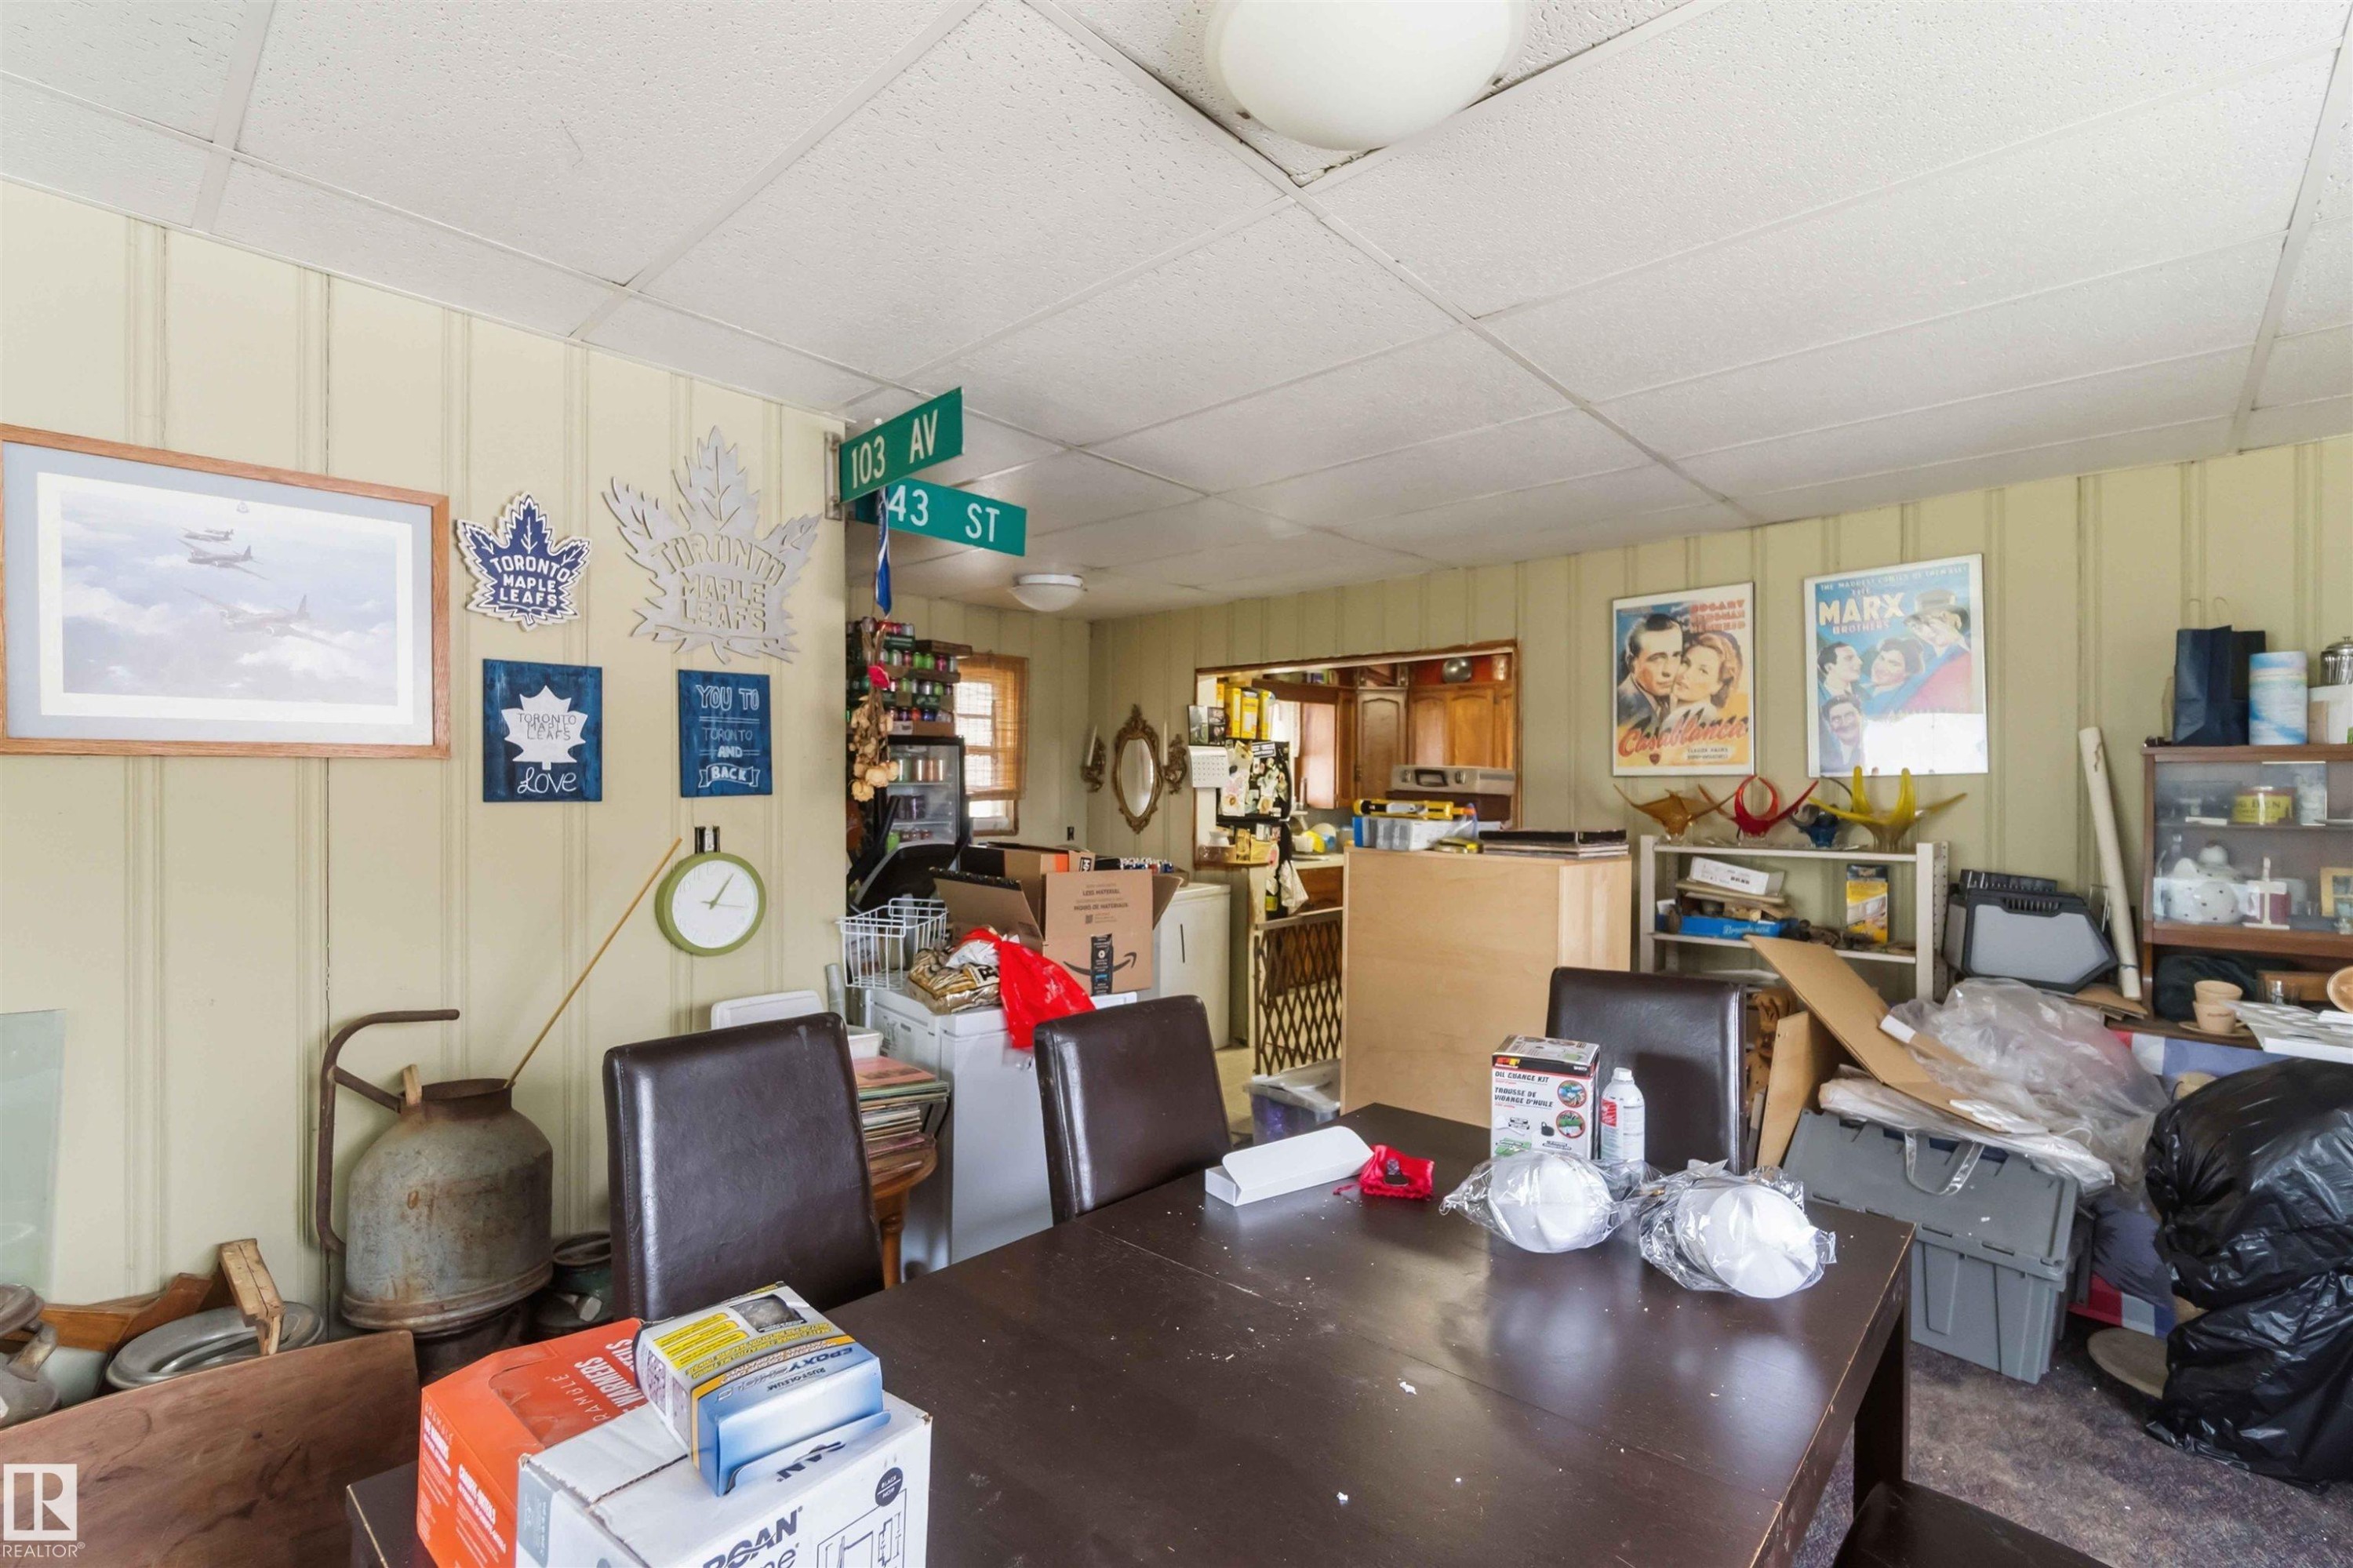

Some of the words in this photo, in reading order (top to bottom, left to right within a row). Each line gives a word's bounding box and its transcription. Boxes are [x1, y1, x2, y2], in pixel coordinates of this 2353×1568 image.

[852, 435, 885, 489] 103
[910, 409, 938, 464] AV
[888, 485, 929, 526] 43
[966, 503, 1000, 542] ST
[649, 533, 786, 586] TORONTO
[489, 555, 570, 582] TORONTO
[504, 573, 556, 593] MAPLE
[680, 572, 766, 608] MAPLE
[500, 588, 557, 607] LEAFS
[682, 598, 766, 633] LEAFS
[1818, 592, 1905, 626] MARX
[1832, 619, 1890, 635] BROTHERS
[696, 685, 733, 711] YOU
[738, 688, 759, 711] TO
[518, 713, 577, 725] TORONTO
[527, 722, 570, 733] MAPLE
[527, 731, 571, 740] LEAFS
[702, 726, 753, 741] TORONTO
[718, 745, 743, 758] AND
[710, 766, 747, 781] BACK
[1507, 1072, 1536, 1082] CHANGE
[1495, 1086, 1526, 1097] TROUSSE
[1494, 1094, 1524, 1104] VIDANGE
[1526, 1098, 1554, 1108] D'HUILE
[574, 1356, 645, 1407] WARMERS
[881, 1475, 897, 1489] BLACK
